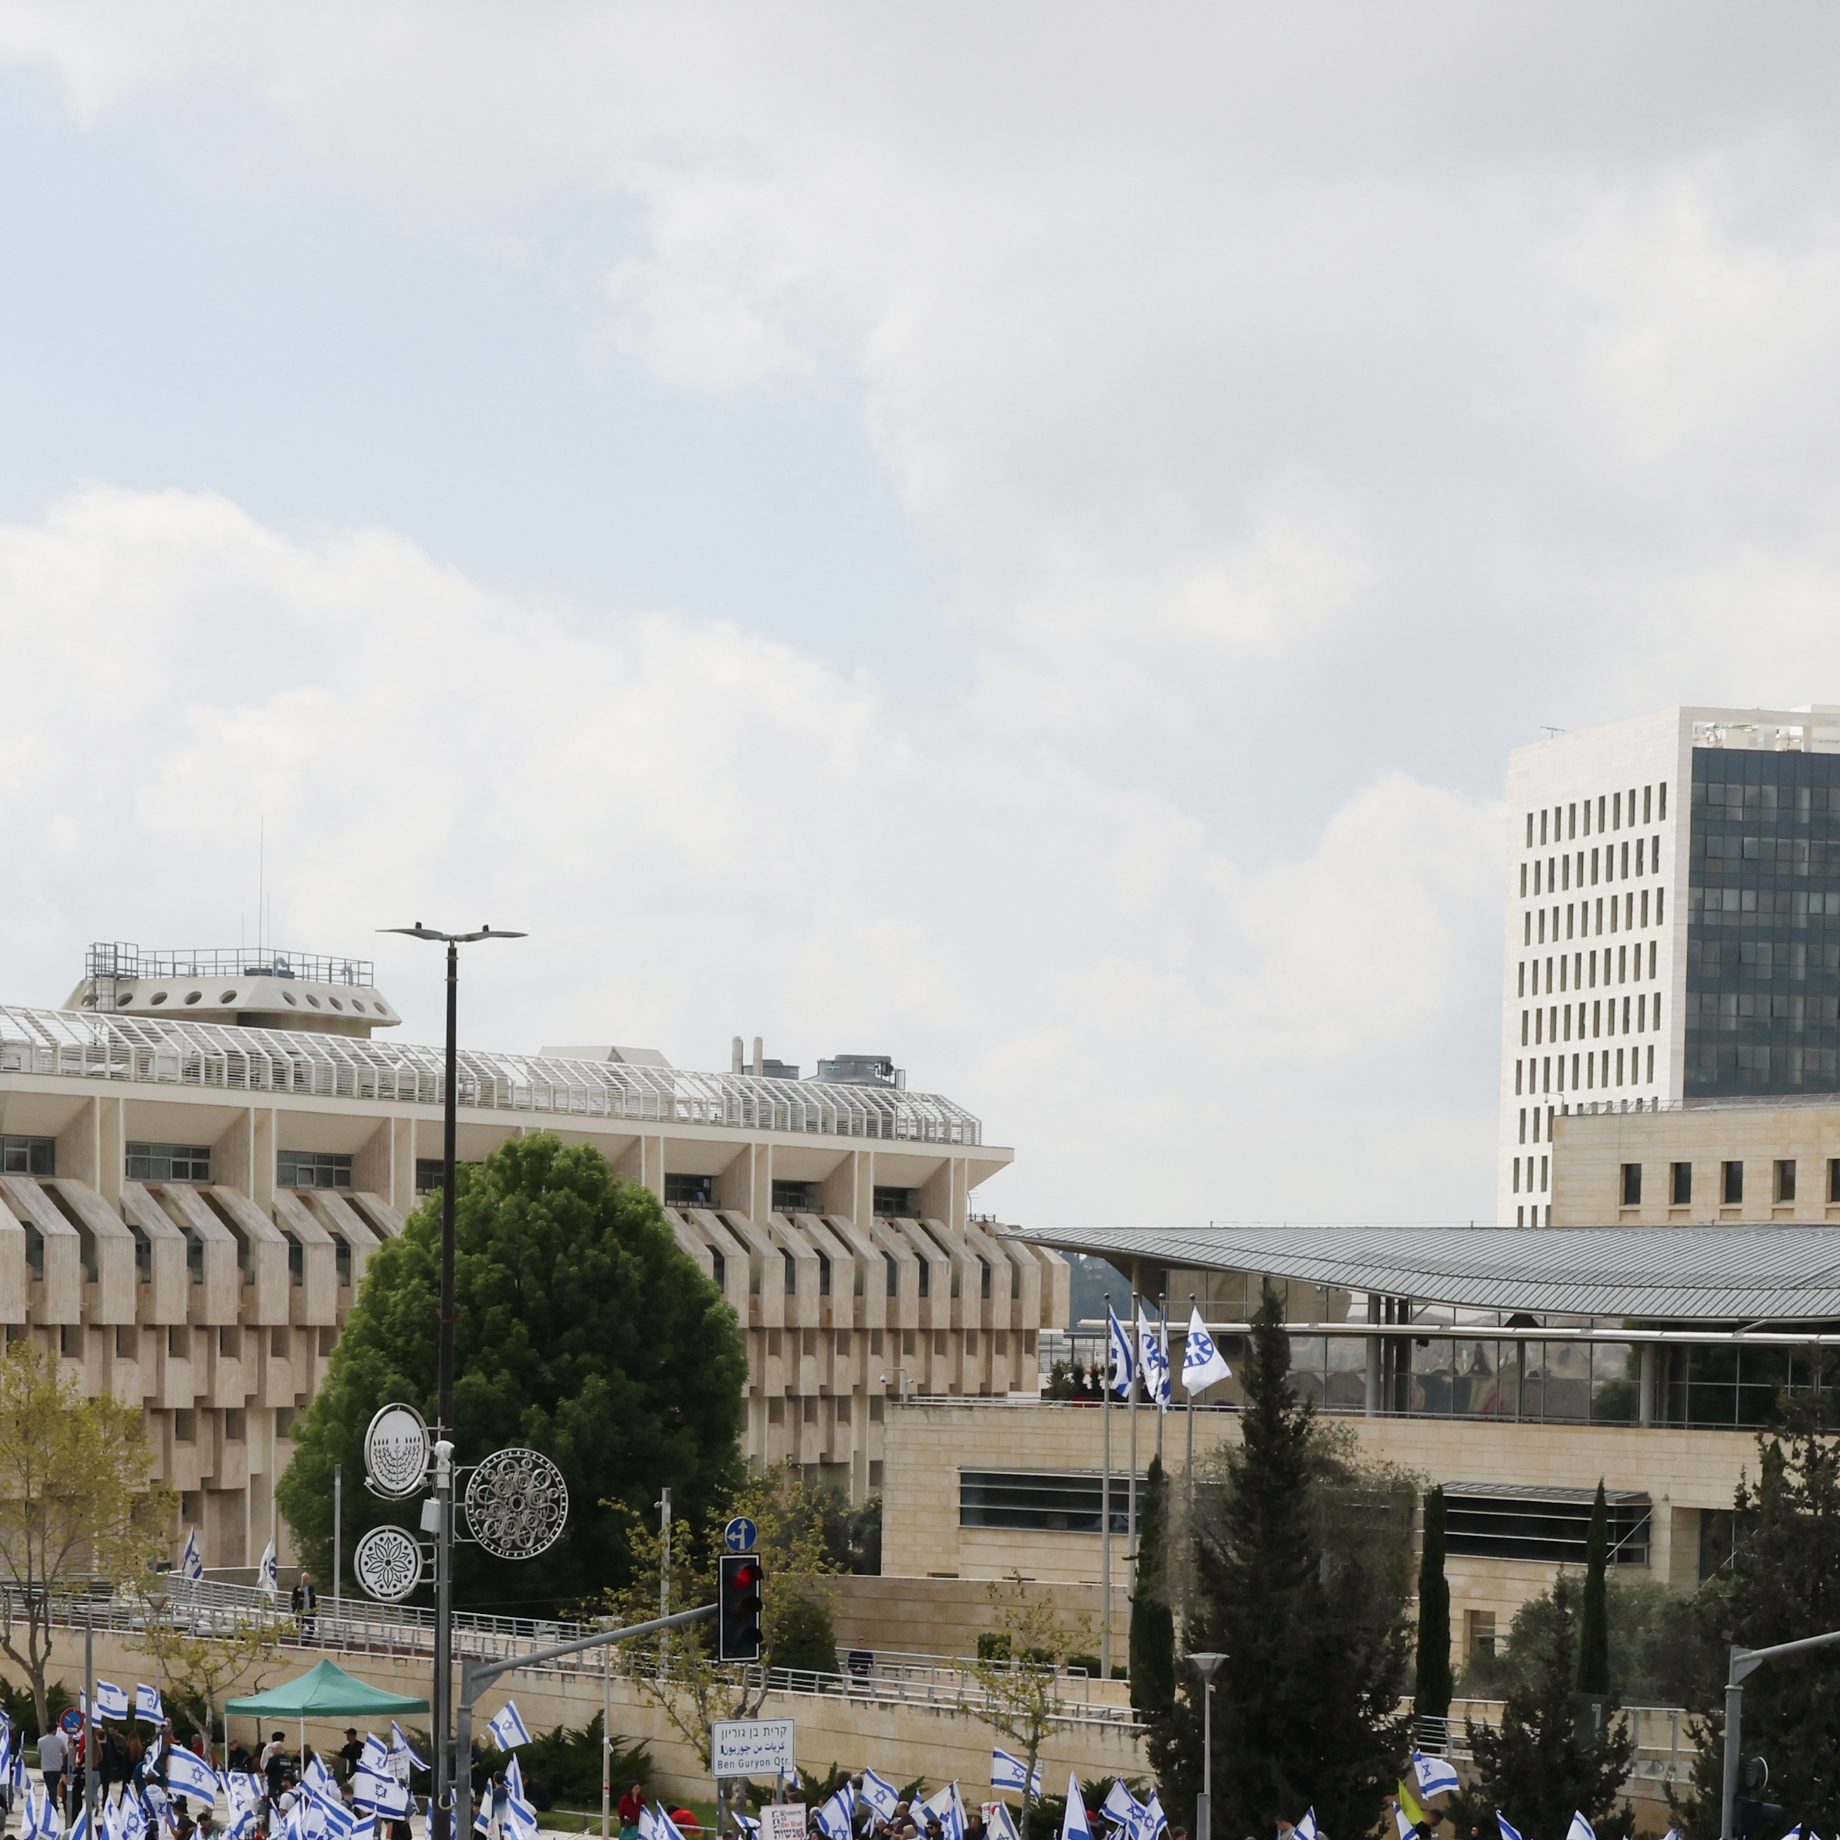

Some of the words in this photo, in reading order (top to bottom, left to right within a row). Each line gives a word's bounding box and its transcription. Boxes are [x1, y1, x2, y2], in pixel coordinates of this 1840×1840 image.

[721, 1729, 746, 1741] גוריון
[750, 1728, 759, 1738] בן
[763, 1726, 787, 1740] קרית
[717, 1759, 734, 1769] Ben
[738, 1758, 770, 1771] Guryon
[774, 1757, 791, 1767] Qtr.
